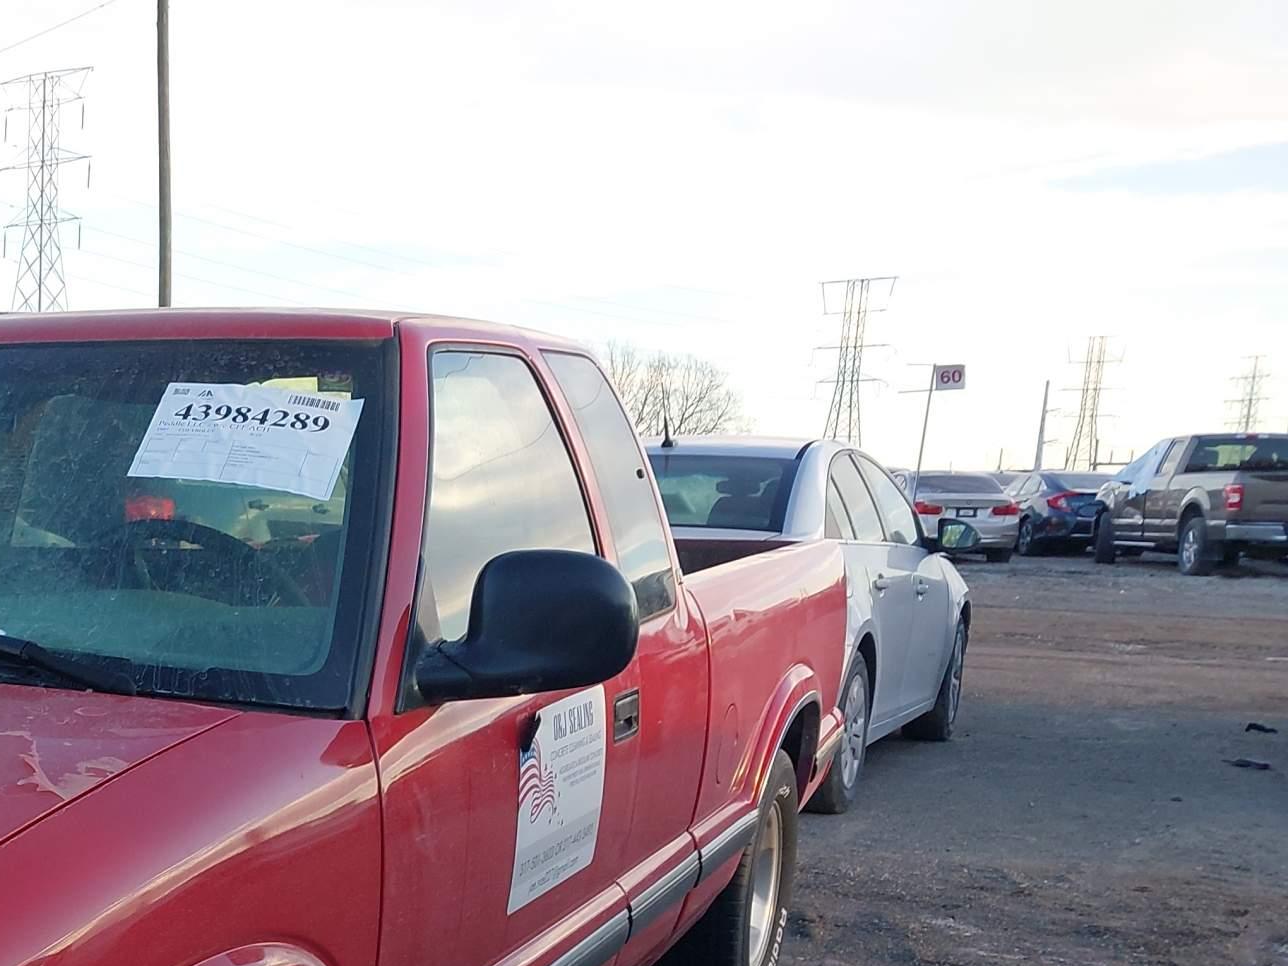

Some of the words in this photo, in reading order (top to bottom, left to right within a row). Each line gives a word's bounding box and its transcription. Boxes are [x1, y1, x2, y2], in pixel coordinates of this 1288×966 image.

[940, 369, 962, 384] 60
[174, 403, 330, 432] 43984289
[553, 711, 567, 741] O&J
[568, 700, 594, 735] SEALING
